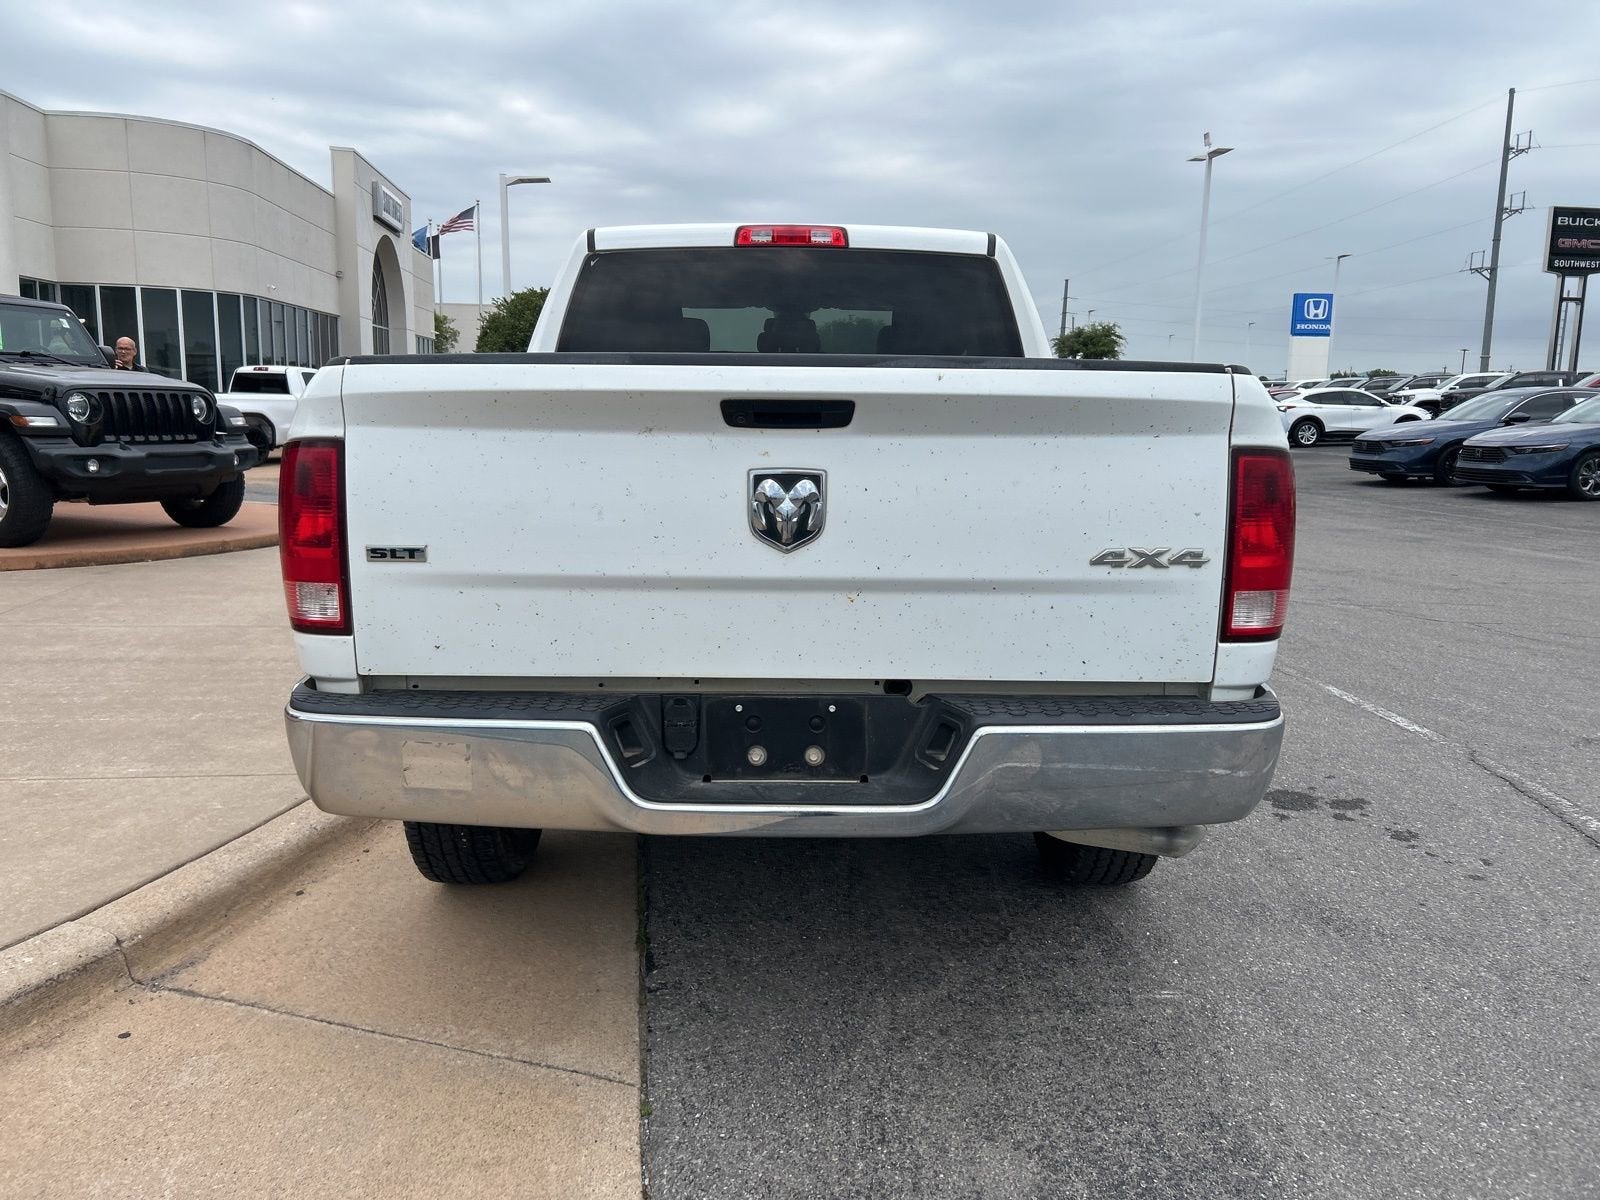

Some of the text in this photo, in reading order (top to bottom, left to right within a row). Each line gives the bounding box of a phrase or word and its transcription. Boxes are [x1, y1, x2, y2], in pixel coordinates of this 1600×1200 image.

[1557, 216, 1600, 227] BUICK
[1557, 237, 1600, 249] GMC
[1554, 259, 1600, 268] SOUTHWEST
[370, 547, 421, 559] SLT
[1089, 547, 1211, 569] 4X4
